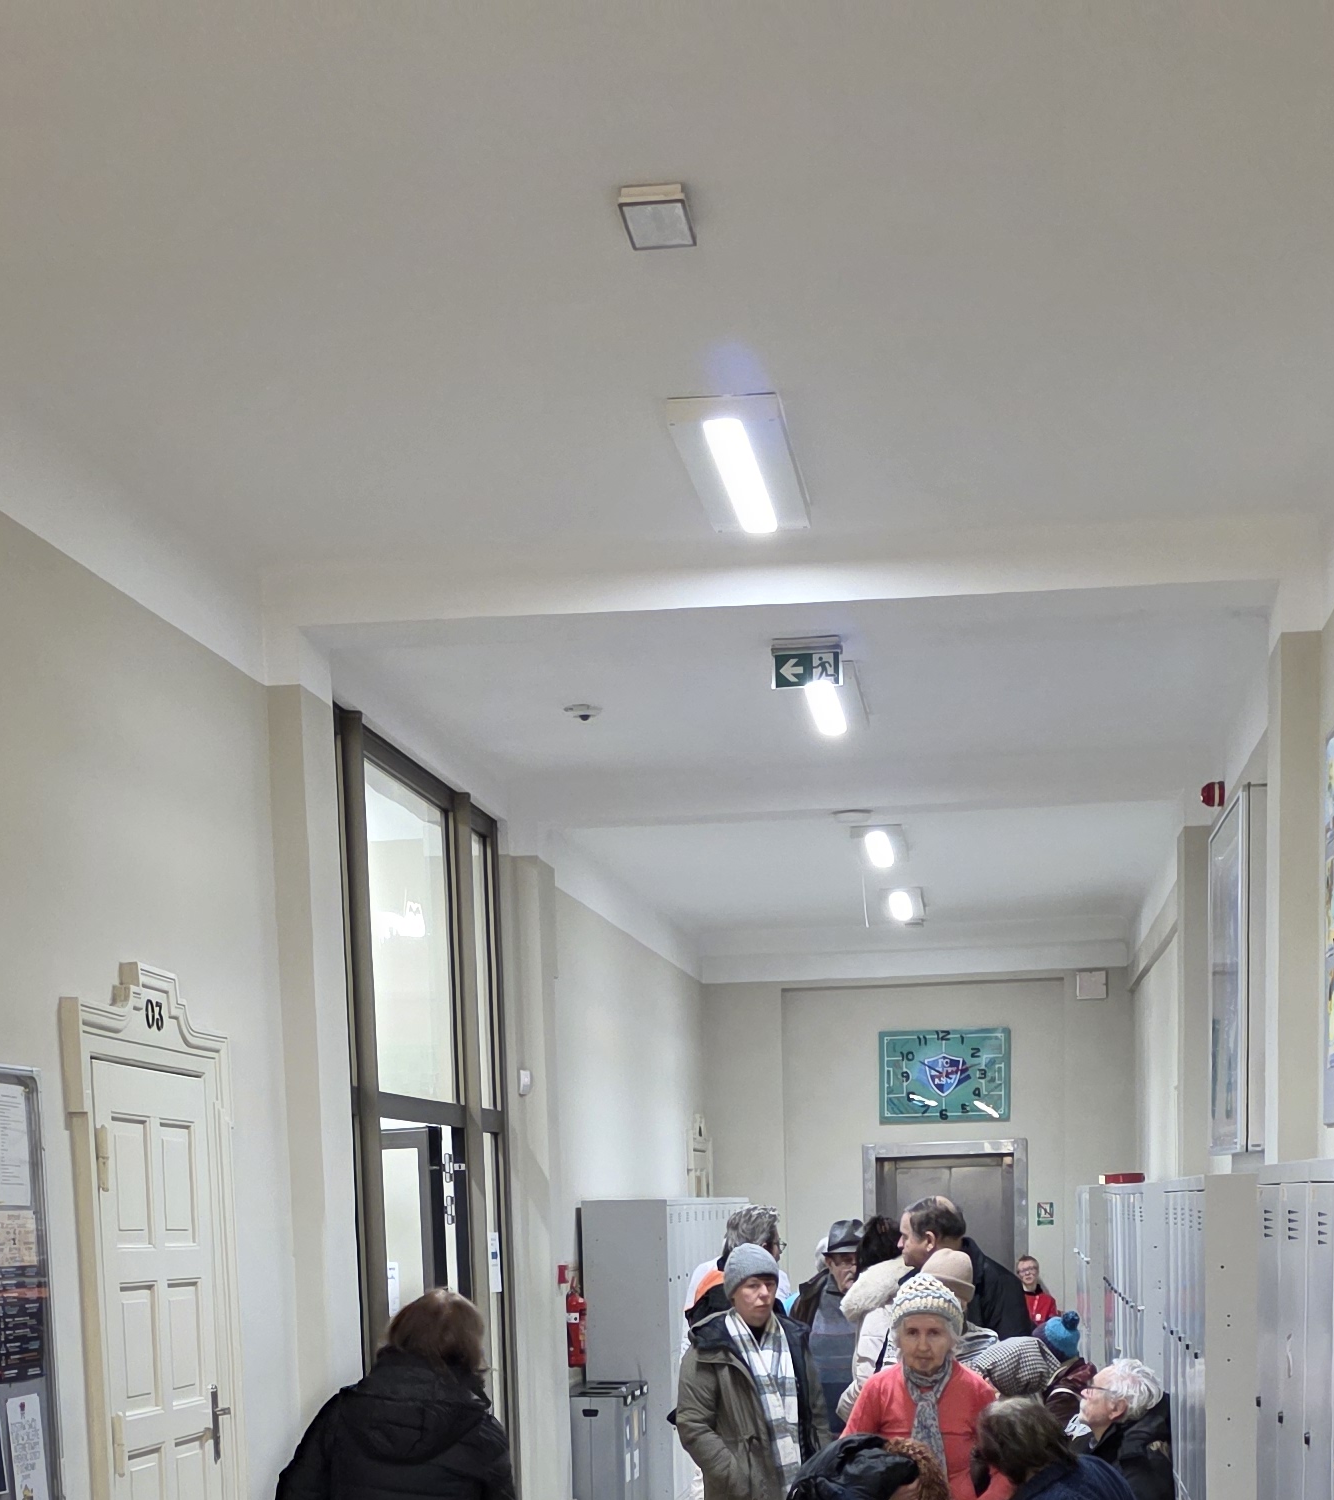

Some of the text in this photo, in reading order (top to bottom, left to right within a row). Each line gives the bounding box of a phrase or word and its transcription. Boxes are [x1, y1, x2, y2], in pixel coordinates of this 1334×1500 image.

[145, 998, 164, 1032] 03
[917, 1035, 928, 1047] 11
[935, 1030, 951, 1042] 12
[959, 1034, 965, 1045] 1
[900, 1051, 915, 1062] 10
[970, 1047, 981, 1058] 2
[901, 1071, 911, 1083] 9
[977, 1068, 987, 1080] 3
[972, 1087, 981, 1098] 4
[938, 1108, 948, 1121] 6
[960, 1103, 970, 1114] 5
